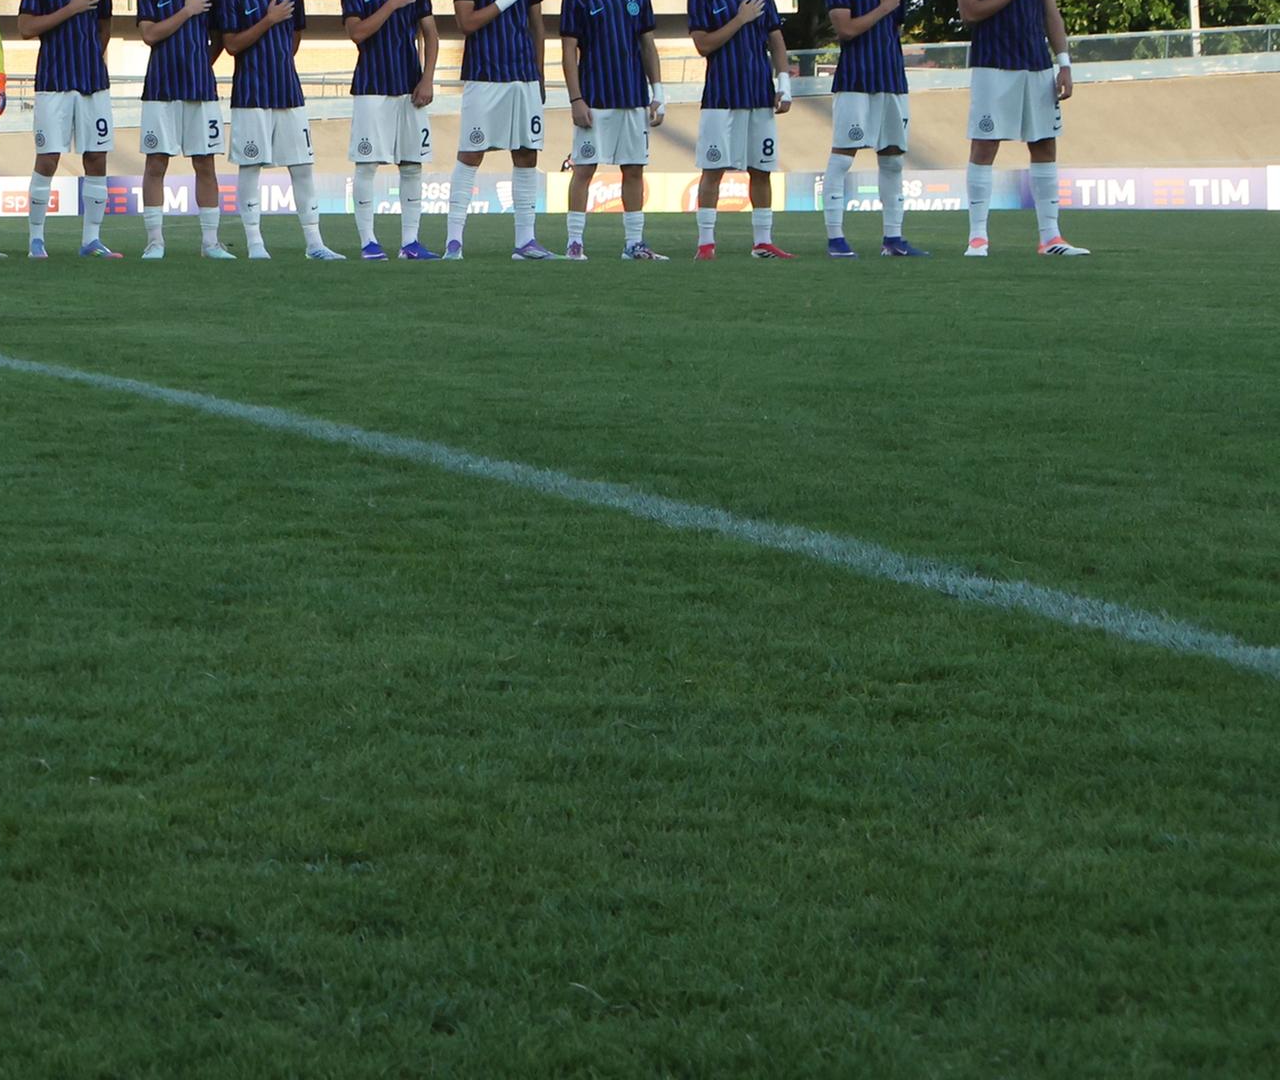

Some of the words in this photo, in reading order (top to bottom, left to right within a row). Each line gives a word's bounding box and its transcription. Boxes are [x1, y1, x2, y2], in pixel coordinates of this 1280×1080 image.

[95, 118, 109, 137] 9
[208, 119, 219, 139] 3
[530, 115, 541, 135] 6
[421, 128, 430, 147] 2
[762, 138, 774, 156] 8
[131, 186, 188, 212] TM
[260, 186, 296, 212] IM
[1076, 178, 1136, 205] TIM
[1189, 178, 1250, 205] TIM
